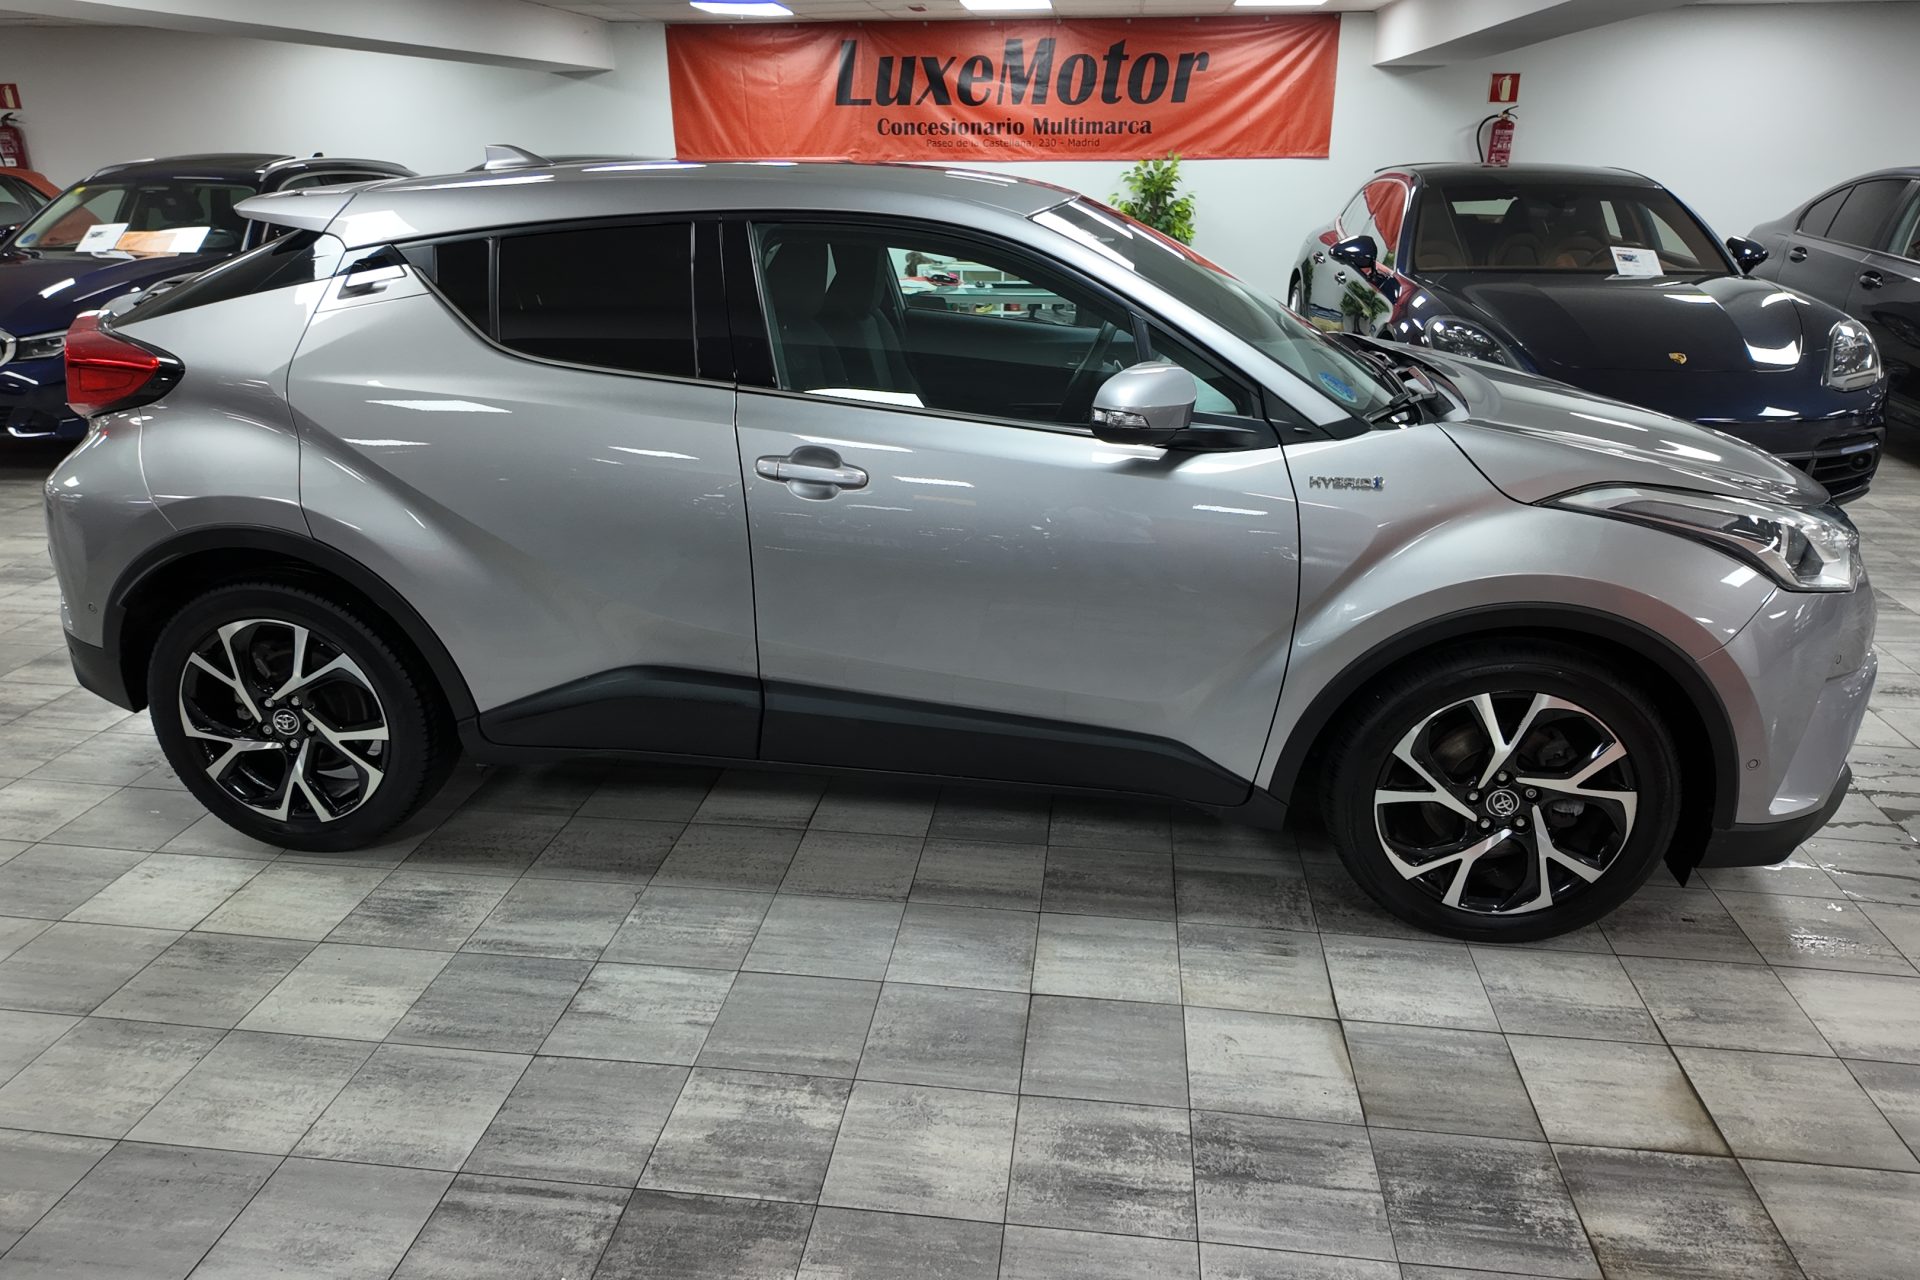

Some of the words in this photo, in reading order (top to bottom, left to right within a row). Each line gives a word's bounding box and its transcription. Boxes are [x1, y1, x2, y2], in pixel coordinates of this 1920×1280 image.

[835, 37, 1210, 107] LuxeMotor
[877, 118, 1025, 136] Concesionario
[1033, 117, 1153, 135] Multimarca
[926, 139, 953, 148] Paseo
[956, 138, 969, 148] de
[1038, 138, 1057, 148] 230
[1068, 138, 1100, 148] Madrid
[1309, 475, 1372, 491] HYBRID
